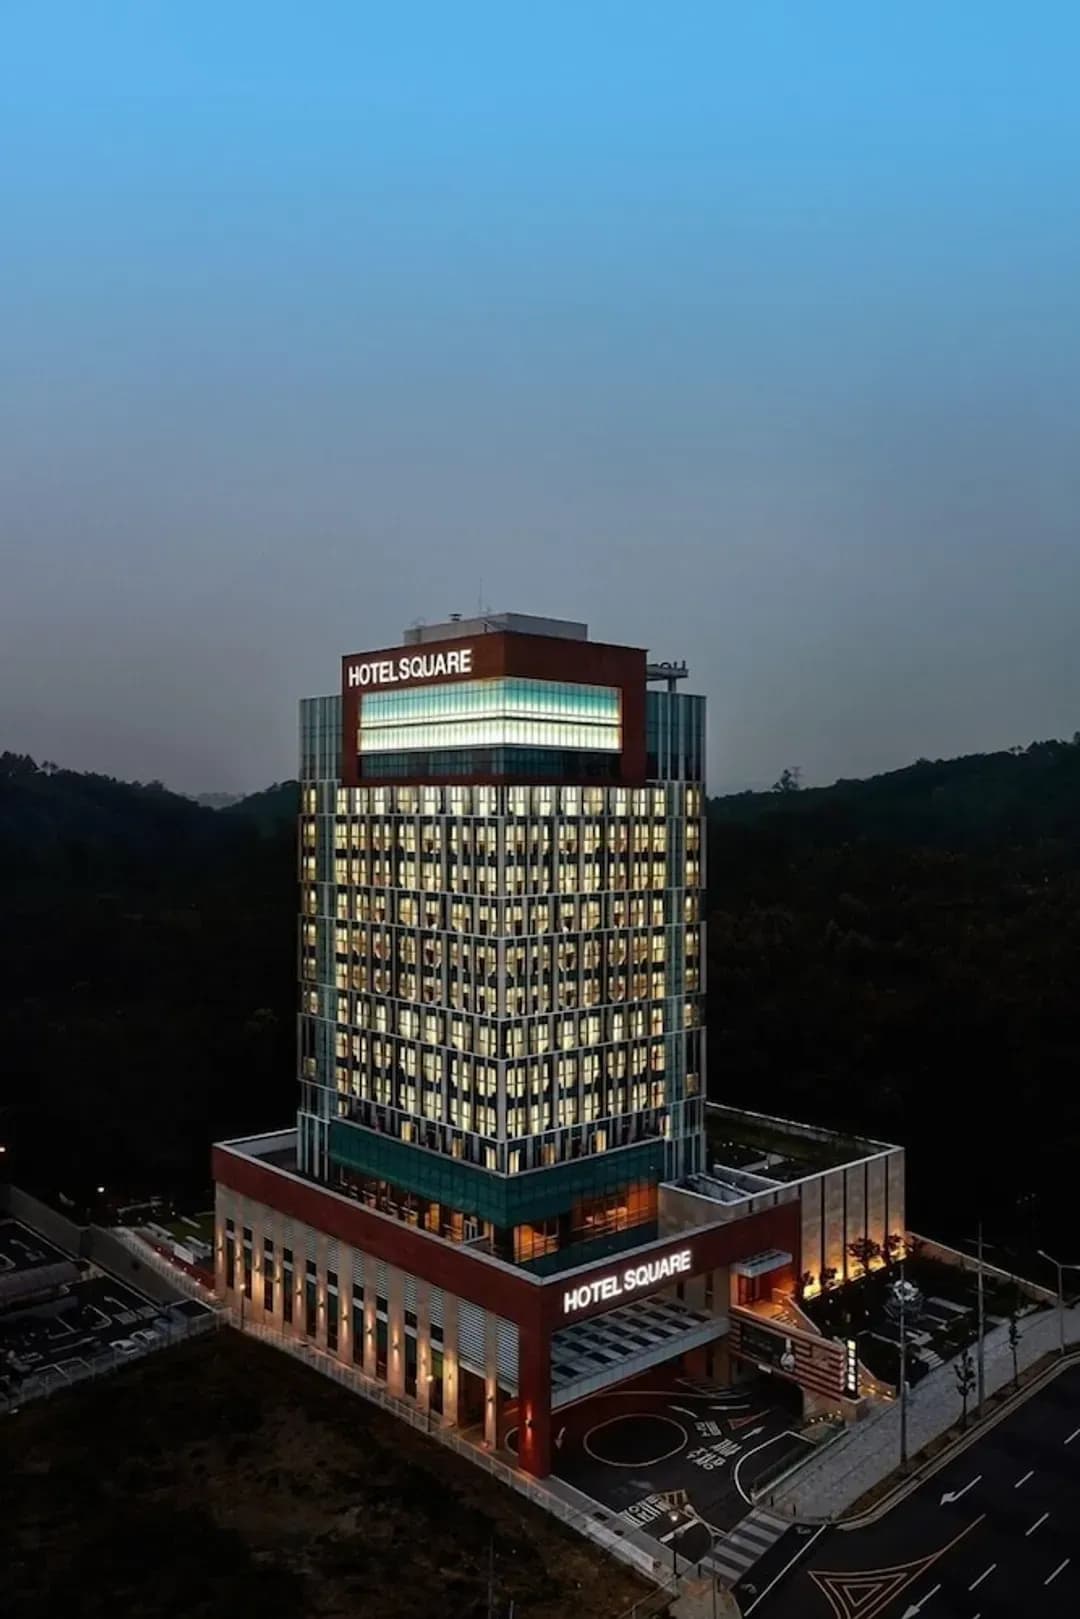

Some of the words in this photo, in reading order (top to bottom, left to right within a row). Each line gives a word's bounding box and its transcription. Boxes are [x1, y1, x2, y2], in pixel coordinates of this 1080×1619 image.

[348, 660, 398, 687] HOTEL
[399, 649, 473, 680] SQUARE
[563, 1275, 622, 1313] HOTEL
[624, 1250, 692, 1290] SQUARE
